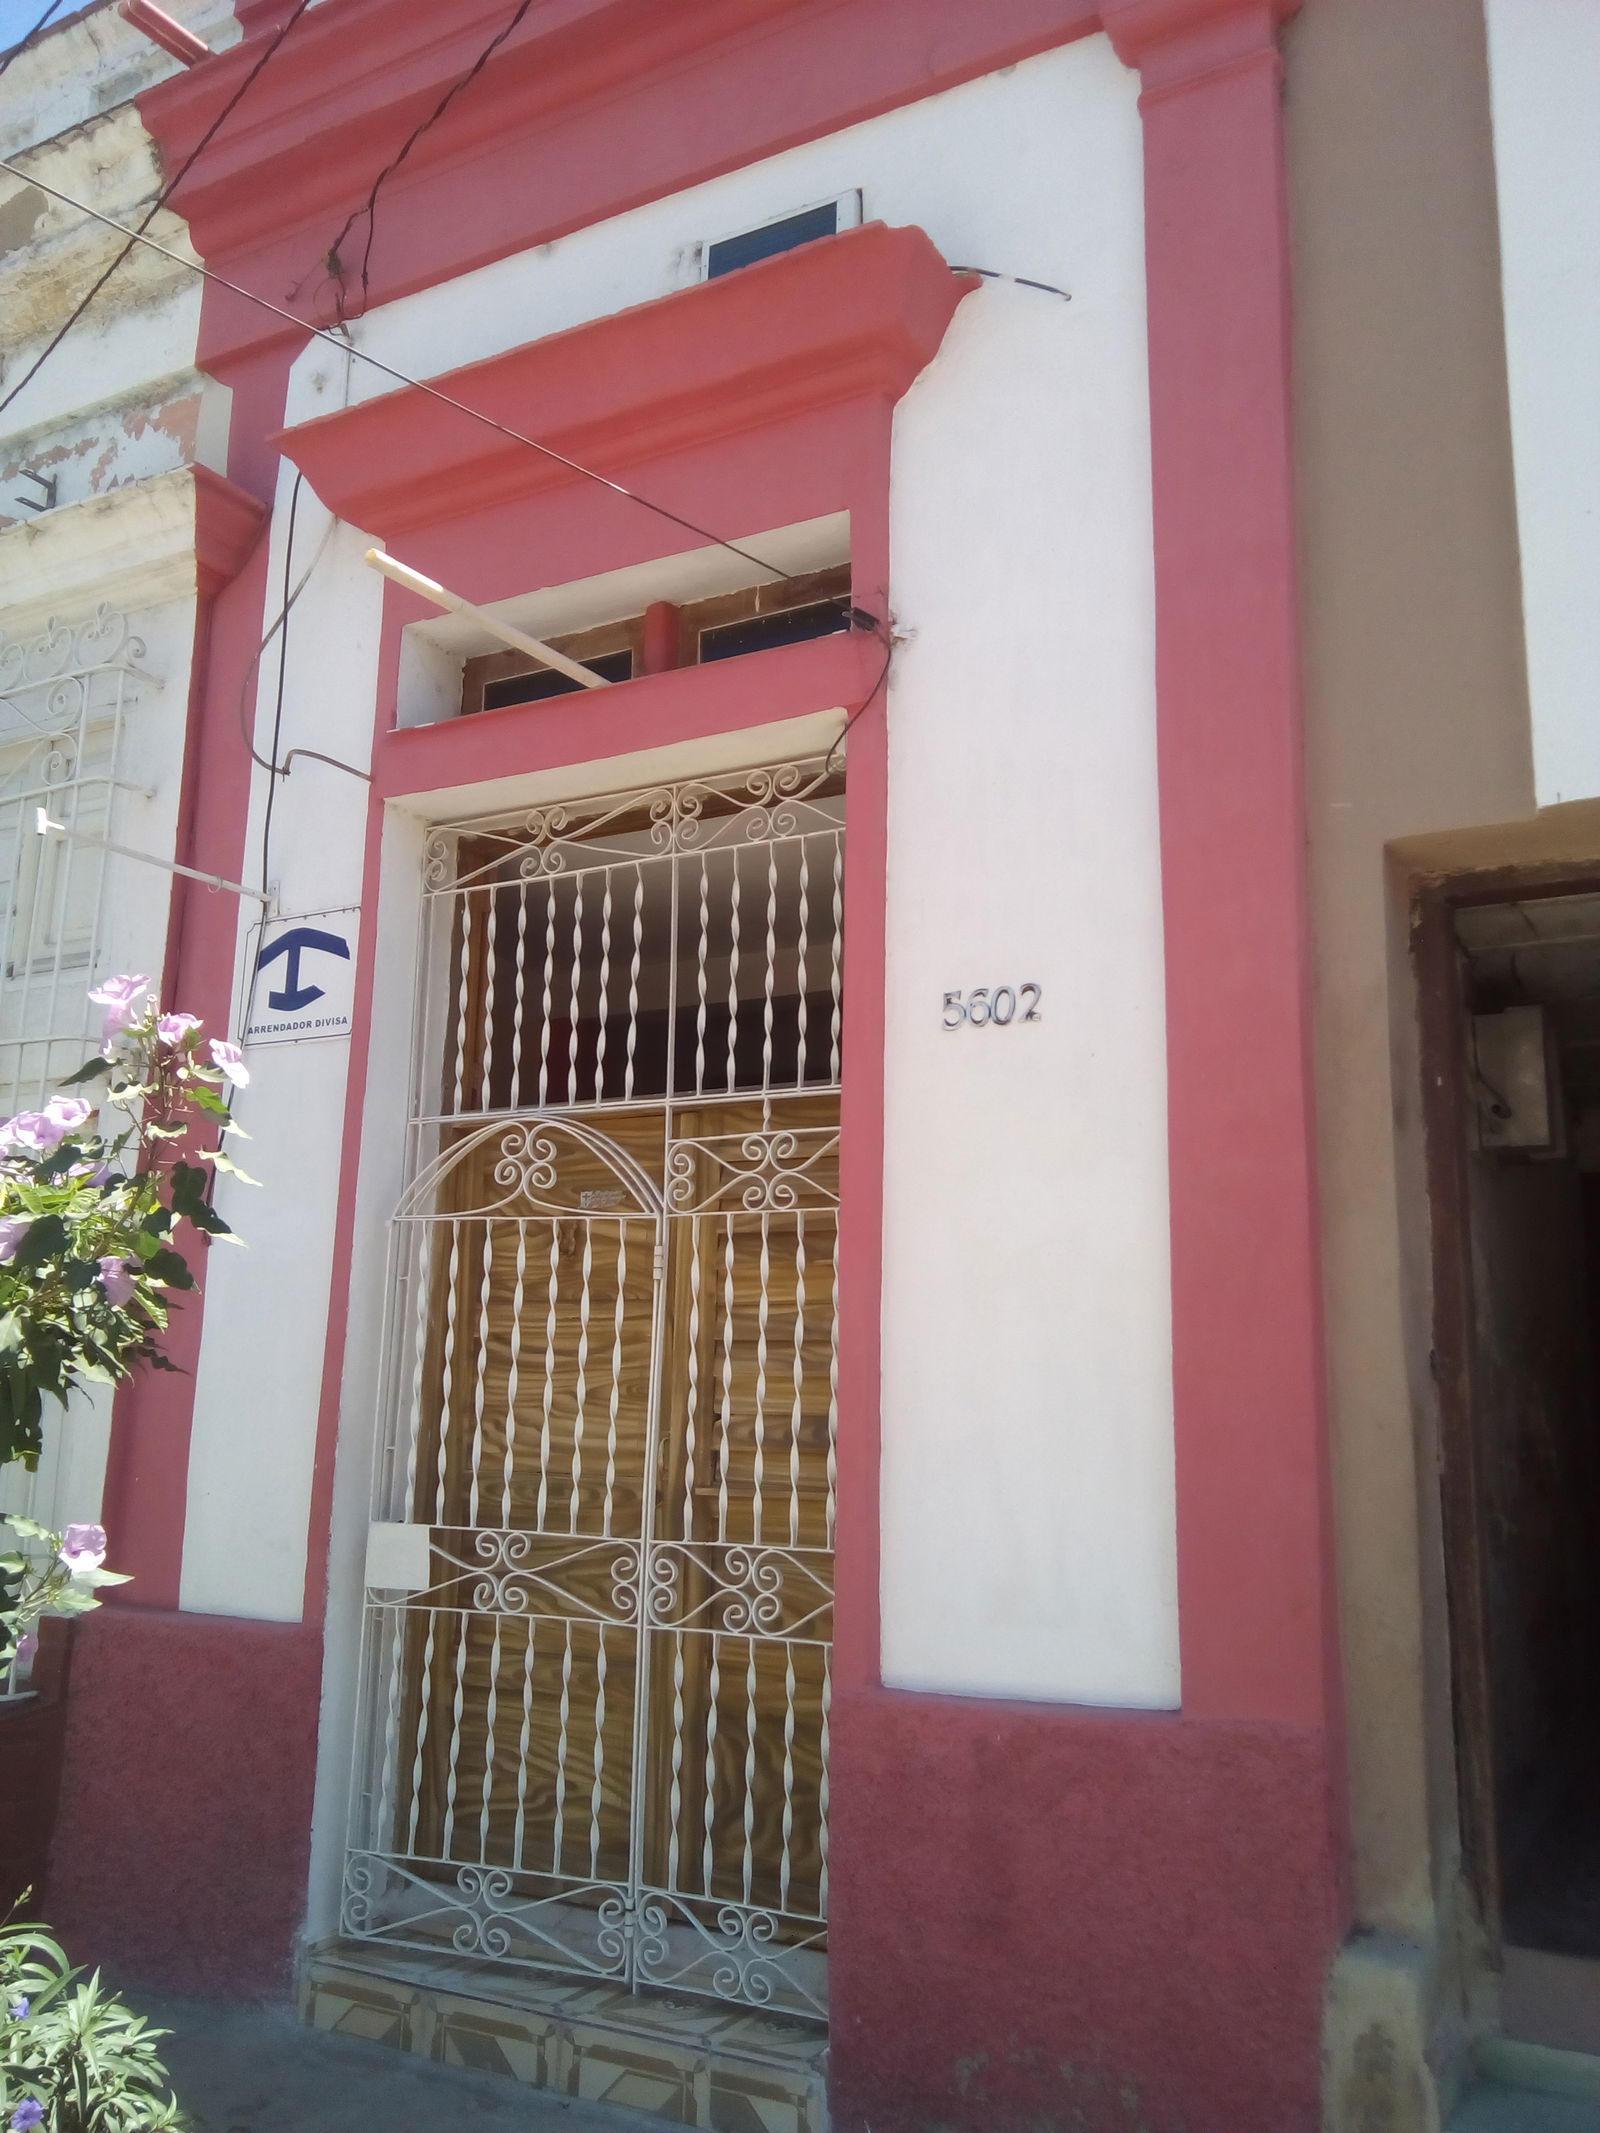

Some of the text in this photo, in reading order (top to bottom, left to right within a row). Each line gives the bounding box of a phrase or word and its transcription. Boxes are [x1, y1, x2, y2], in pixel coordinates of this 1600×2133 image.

[943, 983, 1041, 1031] 5602
[247, 1016, 348, 1035] ARRENDADOR DIVISA
